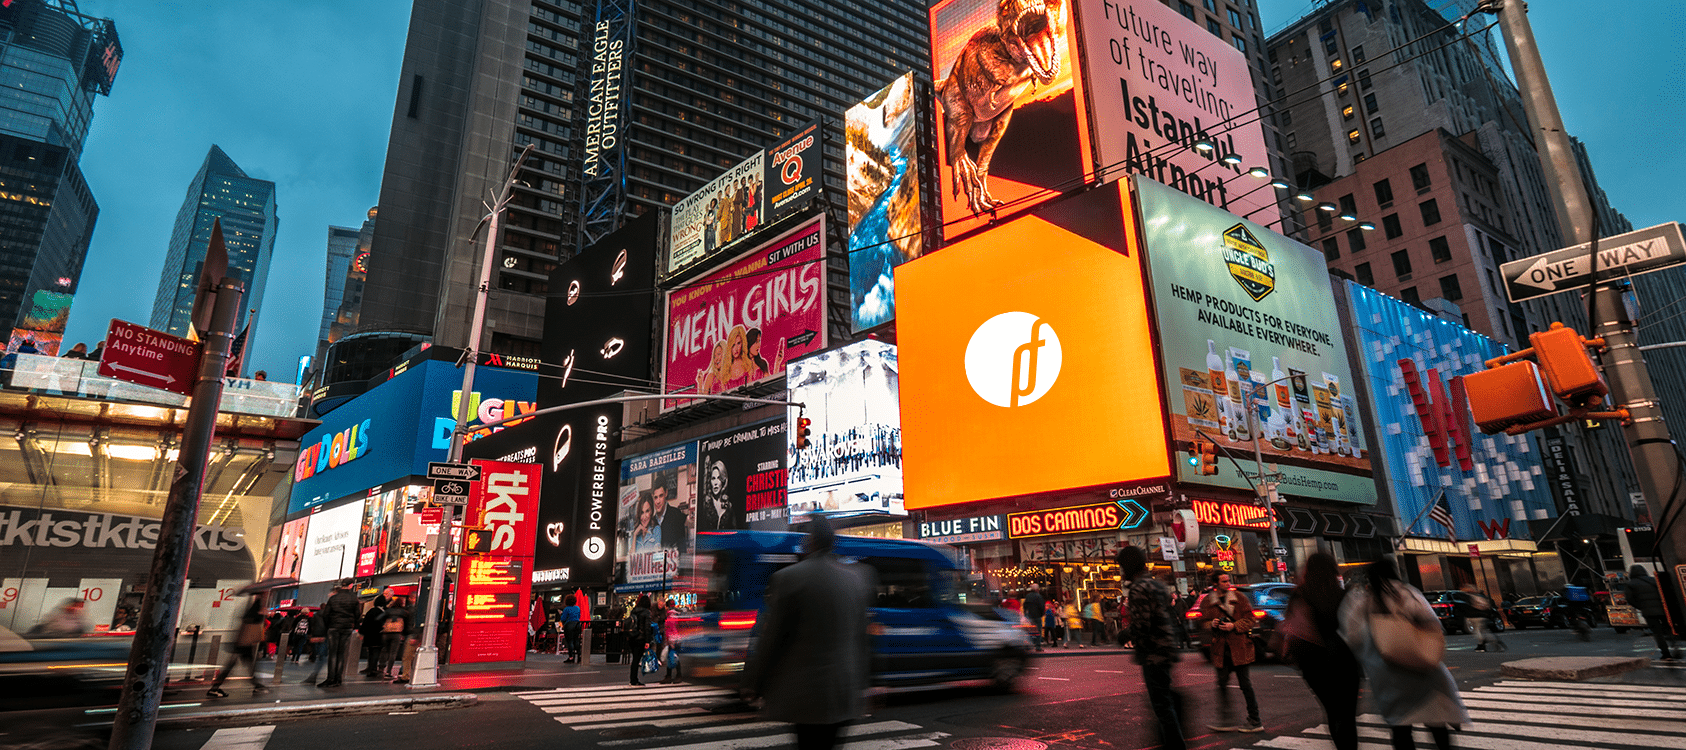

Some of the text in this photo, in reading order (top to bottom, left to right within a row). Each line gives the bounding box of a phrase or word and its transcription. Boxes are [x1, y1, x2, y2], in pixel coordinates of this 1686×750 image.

[1179, 40, 1217, 88] way
[584, 20, 610, 177] AMERICAN EAGLE
[602, 39, 623, 149] OUTFITTERS
[1110, 37, 1237, 131] of traveling:
[1120, 77, 1241, 175] Istanbul
[771, 135, 815, 168] Avenue
[781, 154, 803, 185] Q
[674, 155, 762, 215] SO WRONG IT'S RIGHT
[774, 186, 811, 209] AvenueQ.com
[672, 222, 703, 243] WRONG
[672, 294, 687, 308] YOU
[688, 285, 713, 301] KNOW
[734, 257, 768, 278] WANNA
[769, 251, 781, 265] SIT
[782, 240, 805, 258] WITH
[1530, 241, 1655, 284] ONE WAY
[672, 262, 820, 363] MEAN GIRLS
[1171, 283, 1334, 349] HEMP PRODUCTS FOR EVERYONE,
[115, 327, 194, 356] NO STANDING
[1198, 309, 1320, 357] AVAILABLE EVERYWHERE.
[112, 340, 164, 361] Anytime
[629, 461, 647, 472] SARA
[649, 450, 686, 467] BAREILLES
[757, 459, 779, 472] STARRING
[800, 438, 869, 468] SWAROVS
[436, 467, 473, 477] ONE WAY
[746, 468, 788, 493] CHRISTI
[485, 470, 529, 550] tkts
[1011, 506, 1118, 536] DOS CAMINOS
[1192, 499, 1221, 524] DOS
[921, 515, 999, 537] BLUE FIN
[1477, 518, 1510, 540] W
[3, 587, 235, 602] 9 10 12
